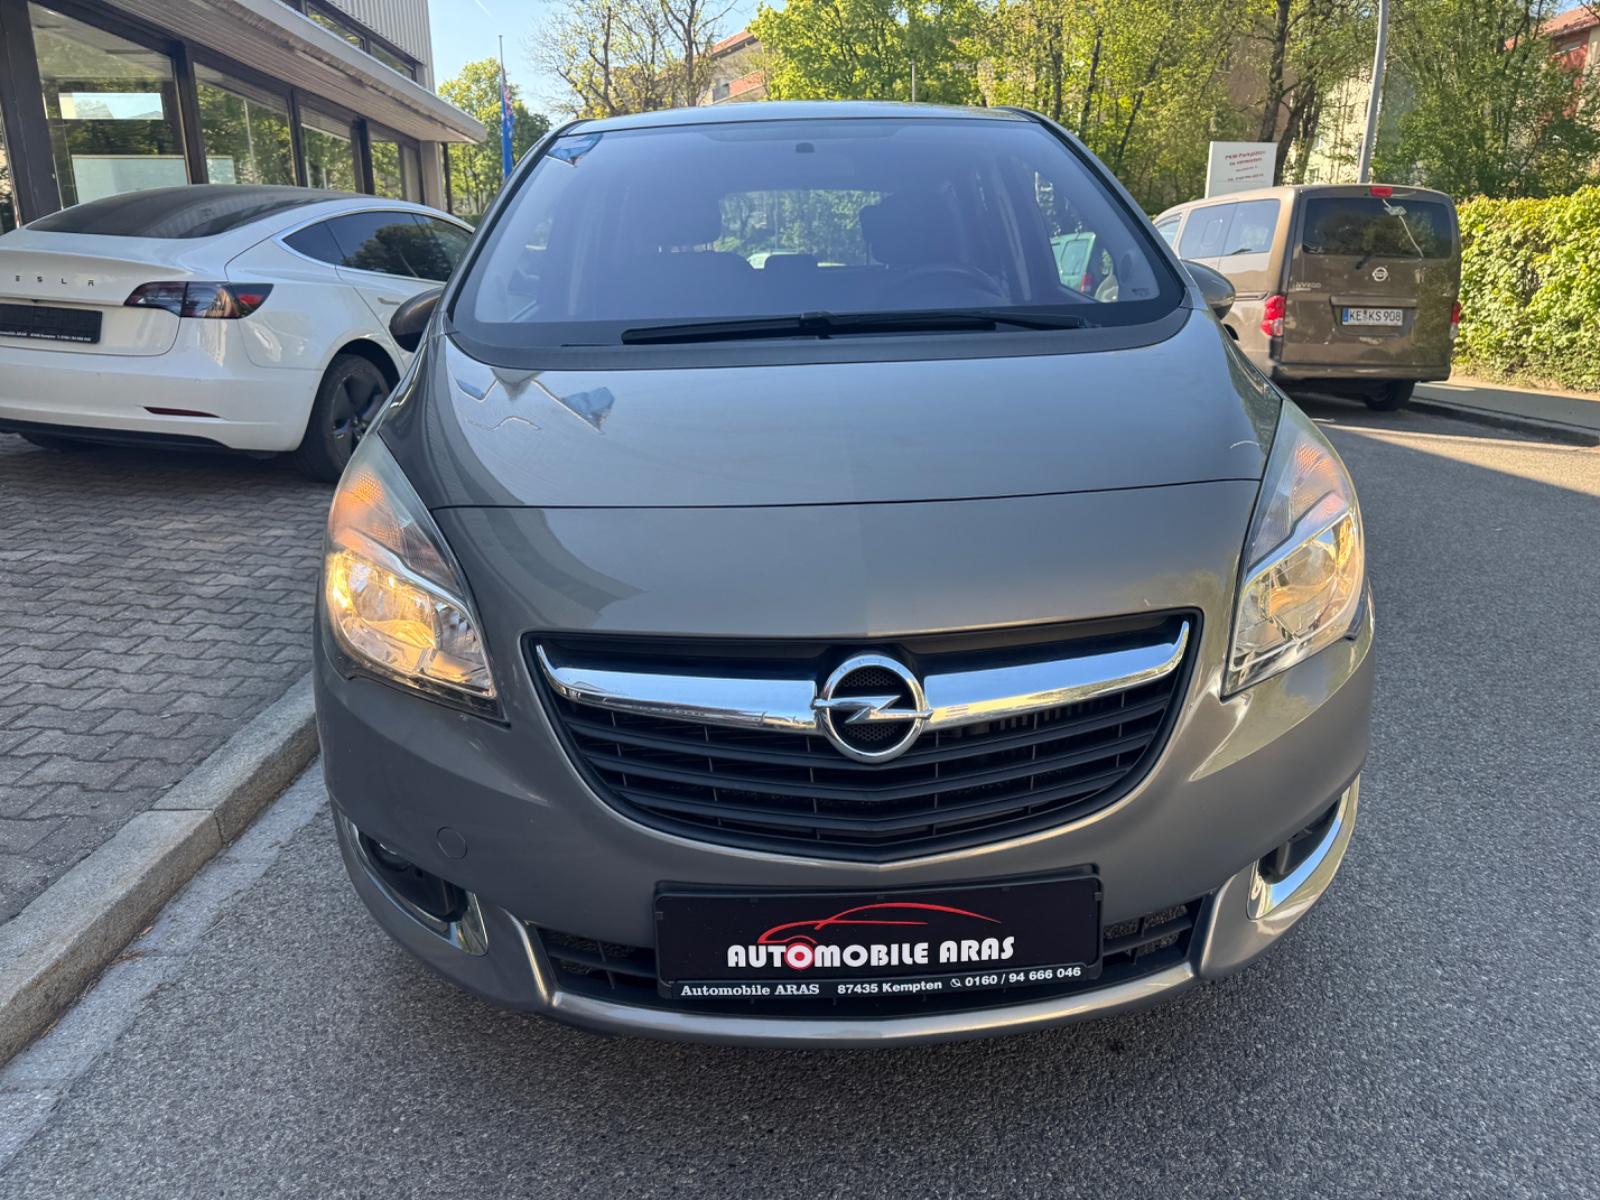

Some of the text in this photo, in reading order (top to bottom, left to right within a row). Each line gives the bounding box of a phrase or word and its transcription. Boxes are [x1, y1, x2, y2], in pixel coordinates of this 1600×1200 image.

[727, 936, 1015, 969] AUTOMOBILE ARAS
[680, 984, 771, 996] Automobile
[774, 984, 820, 995] ARAS
[837, 983, 879, 995] 87435
[882, 980, 943, 993] Kempten
[965, 975, 998, 987] 0160
[1009, 973, 1025, 984] 94
[1029, 969, 1053, 981] 666
[1056, 967, 1081, 978] 046
